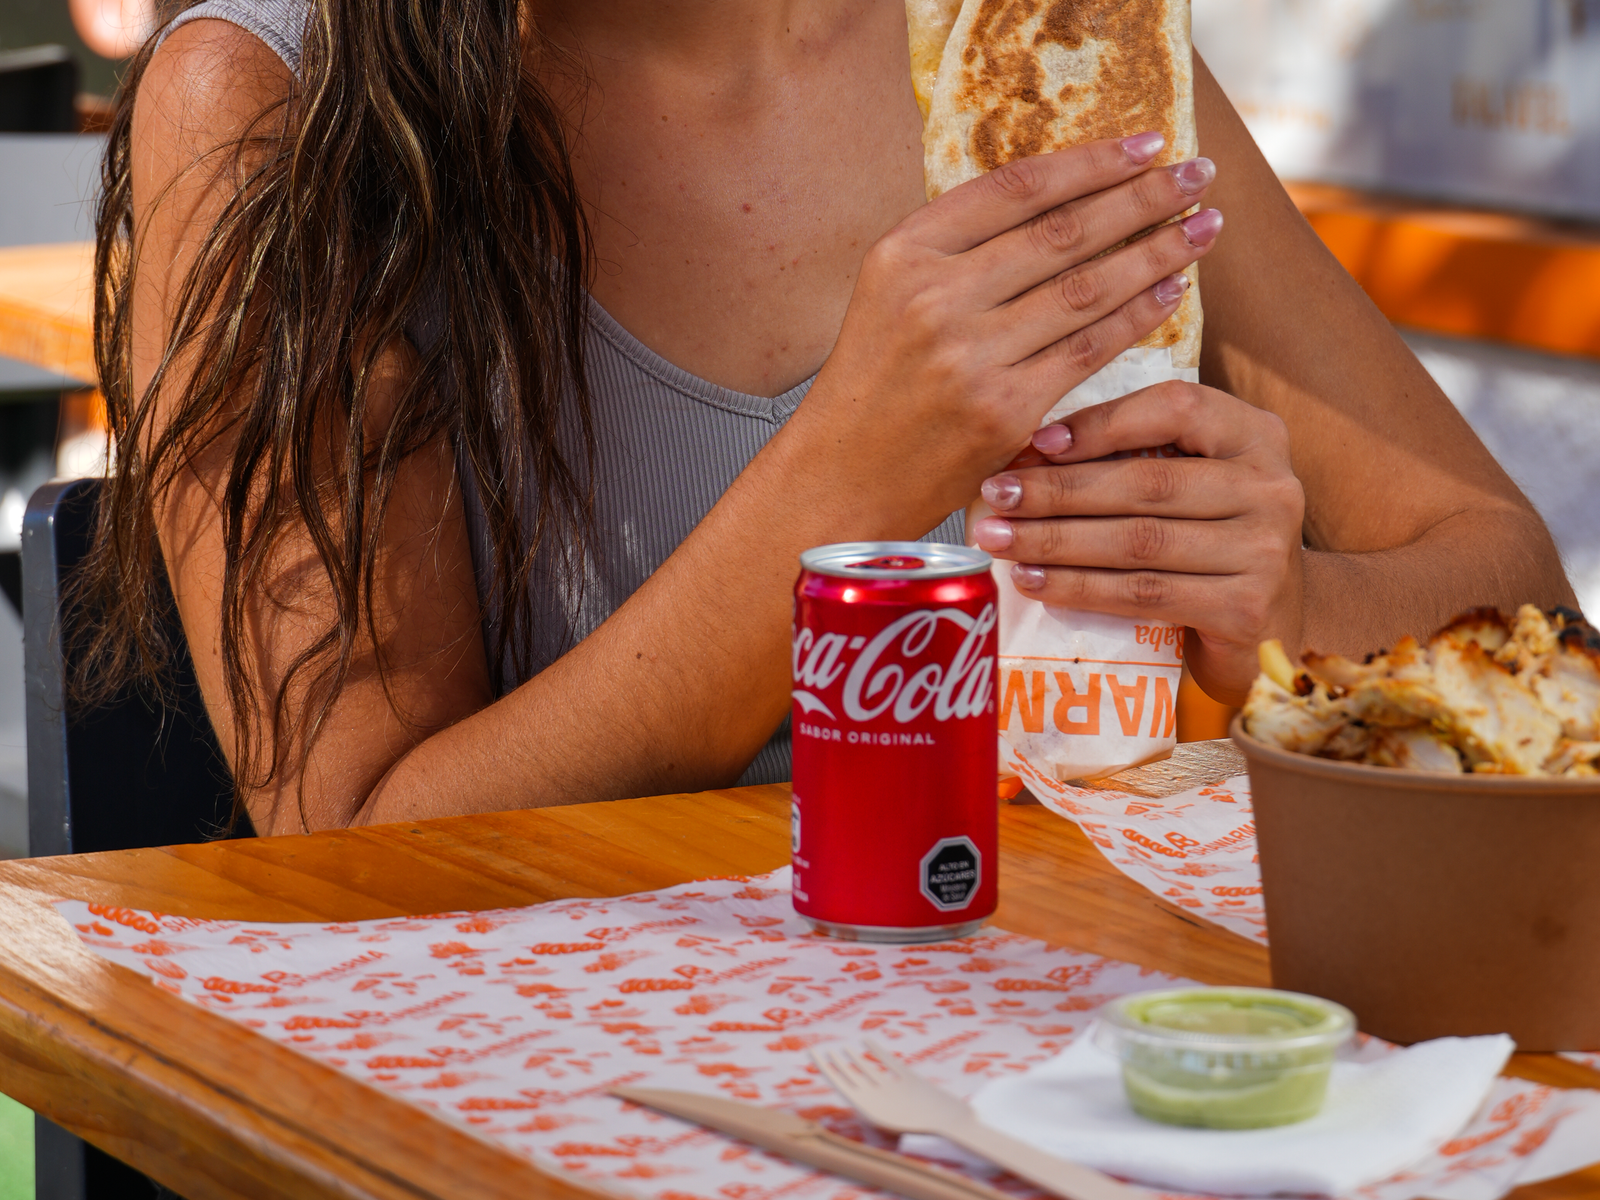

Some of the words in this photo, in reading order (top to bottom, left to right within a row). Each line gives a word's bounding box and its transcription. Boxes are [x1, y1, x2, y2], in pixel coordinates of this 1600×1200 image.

[793, 602, 998, 722] ca-Cola
[800, 722, 841, 742] SABOR
[847, 730, 935, 746] ORIGINAL
